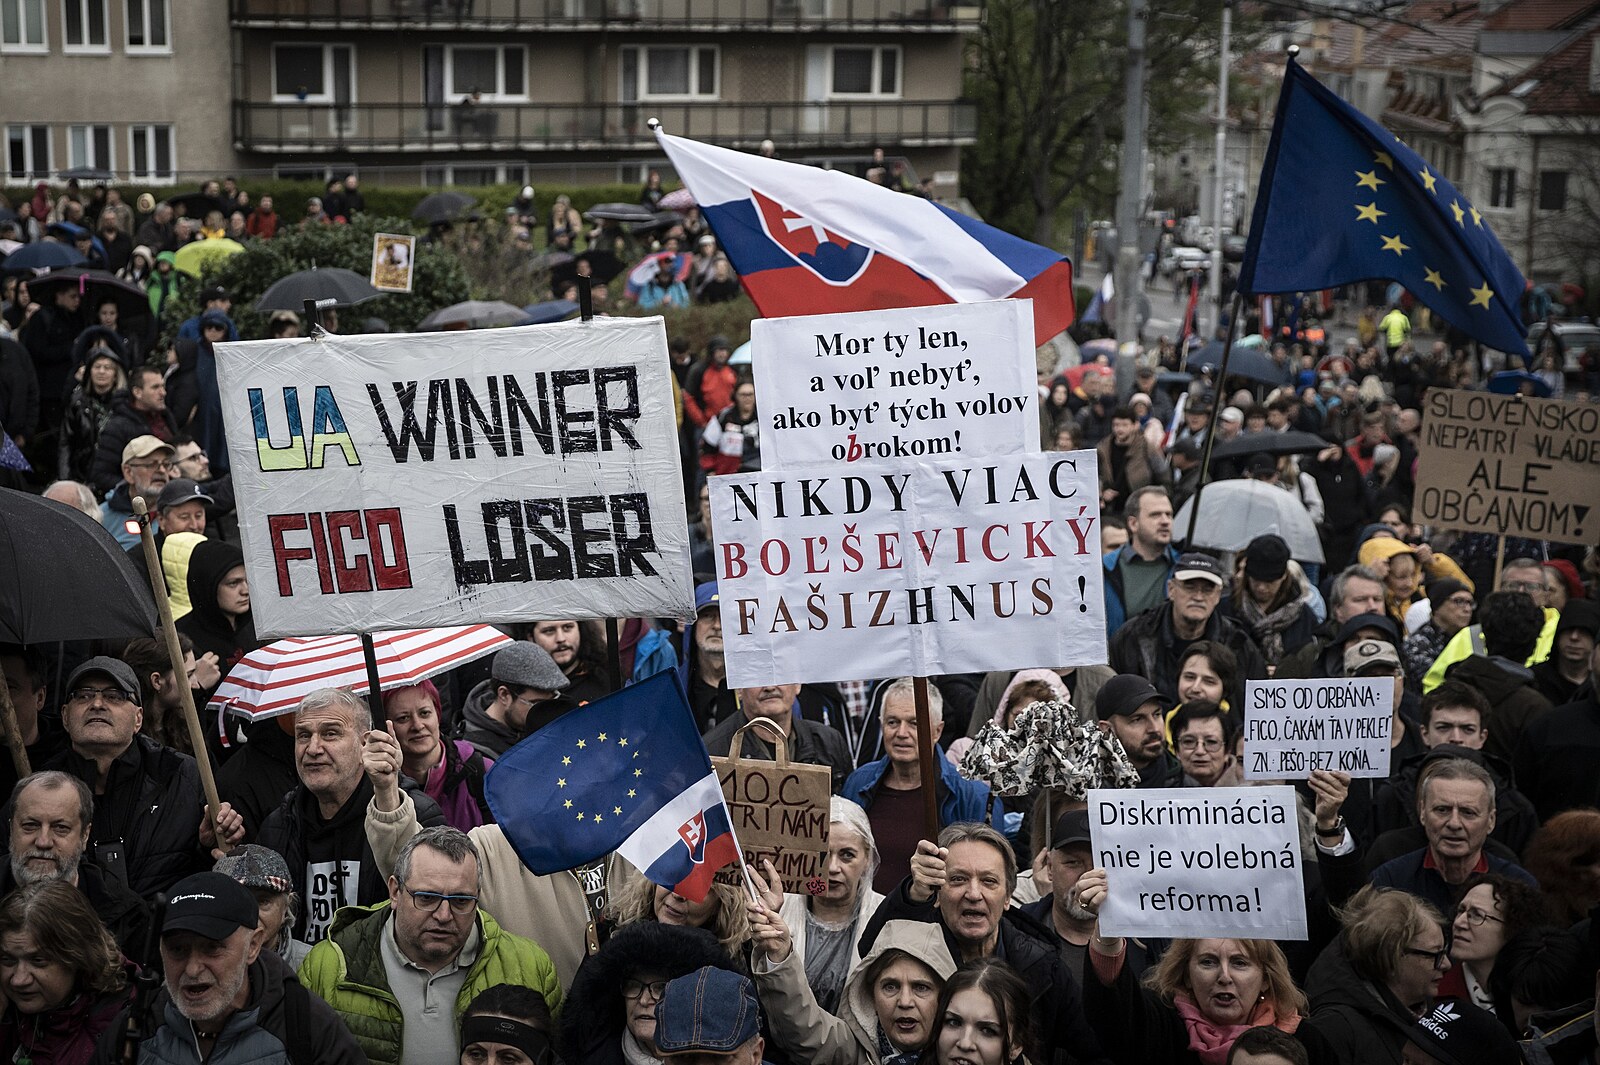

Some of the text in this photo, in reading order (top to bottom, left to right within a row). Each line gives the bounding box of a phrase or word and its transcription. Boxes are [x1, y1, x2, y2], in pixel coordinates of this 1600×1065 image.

[814, 326, 968, 358] Mor ty len,
[810, 358, 981, 392] a voľ nebyť,
[247, 363, 643, 473] UA WINNER
[773, 392, 1029, 431] ako byť tých volov
[1430, 391, 1599, 434] SLOVENSKO
[831, 430, 962, 462] obrokom!
[1427, 423, 1519, 454] NEPATRÍ
[729, 459, 1078, 522] NIKDY VIAC
[1467, 458, 1552, 495] ALE
[1421, 486, 1591, 536] OBČANOM!
[267, 491, 661, 598] FICO LOSER
[719, 505, 1096, 580] BOĽŠEVICKÝ
[1253, 681, 1381, 709] SMS OD ORBÁNA:
[1284, 715, 1325, 741] ČAKÁM
[1328, 715, 1343, 740] ŤA
[1344, 718, 1354, 739] V
[780, 804, 829, 843] NÁM,
[1099, 798, 1286, 826] Diskriminácia
[1100, 842, 1295, 875] nie je volebná
[171, 892, 216, 905] Champion
[1139, 886, 1262, 913] reforma!
[1418, 1017, 1449, 1040] adidas
